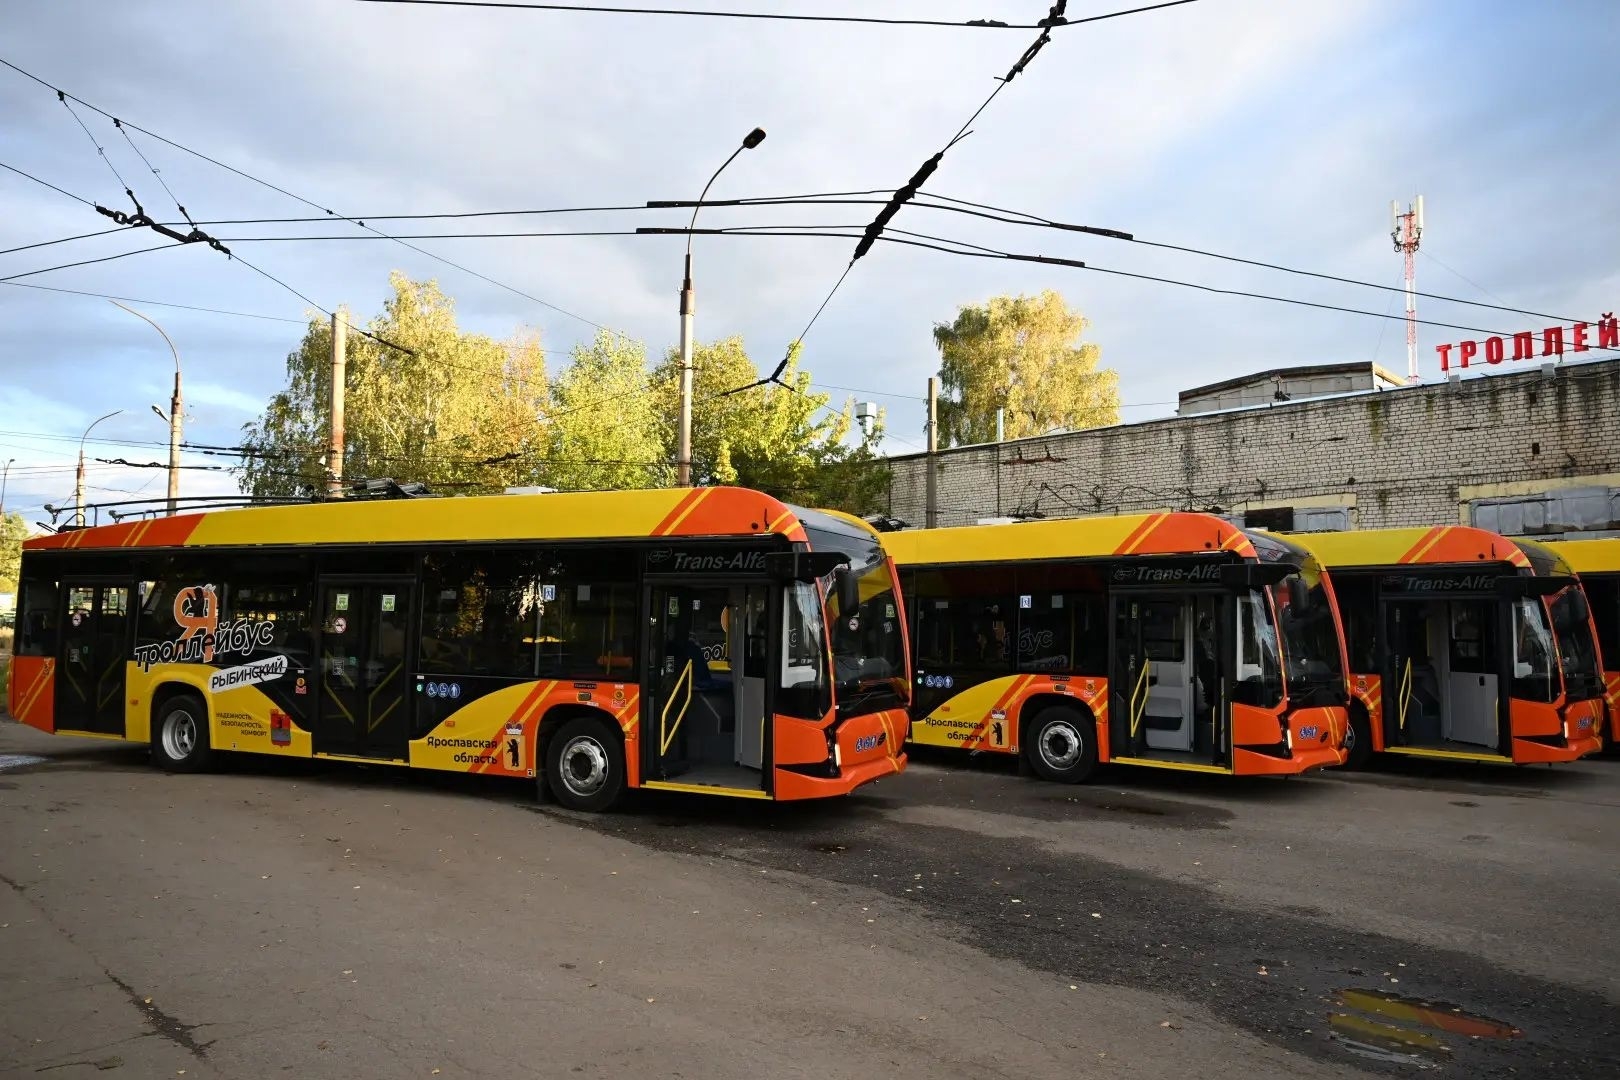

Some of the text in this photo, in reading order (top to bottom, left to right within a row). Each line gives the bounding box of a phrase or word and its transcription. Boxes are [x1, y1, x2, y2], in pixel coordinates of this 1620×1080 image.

[1436, 312, 1619, 372] ТРОЛЛЕЙ
[673, 551, 767, 569] Trans-Alfa
[1136, 564, 1220, 580] Trans-Alfa
[1406, 575, 1495, 590] Trans-Alfa
[134, 618, 274, 675] троллейбус
[211, 657, 284, 689] РЫБИНСКИЙ
[925, 717, 985, 730] Ярославская
[427, 736, 498, 749] Ярославская
[947, 731, 985, 742] область
[453, 751, 498, 765] область
